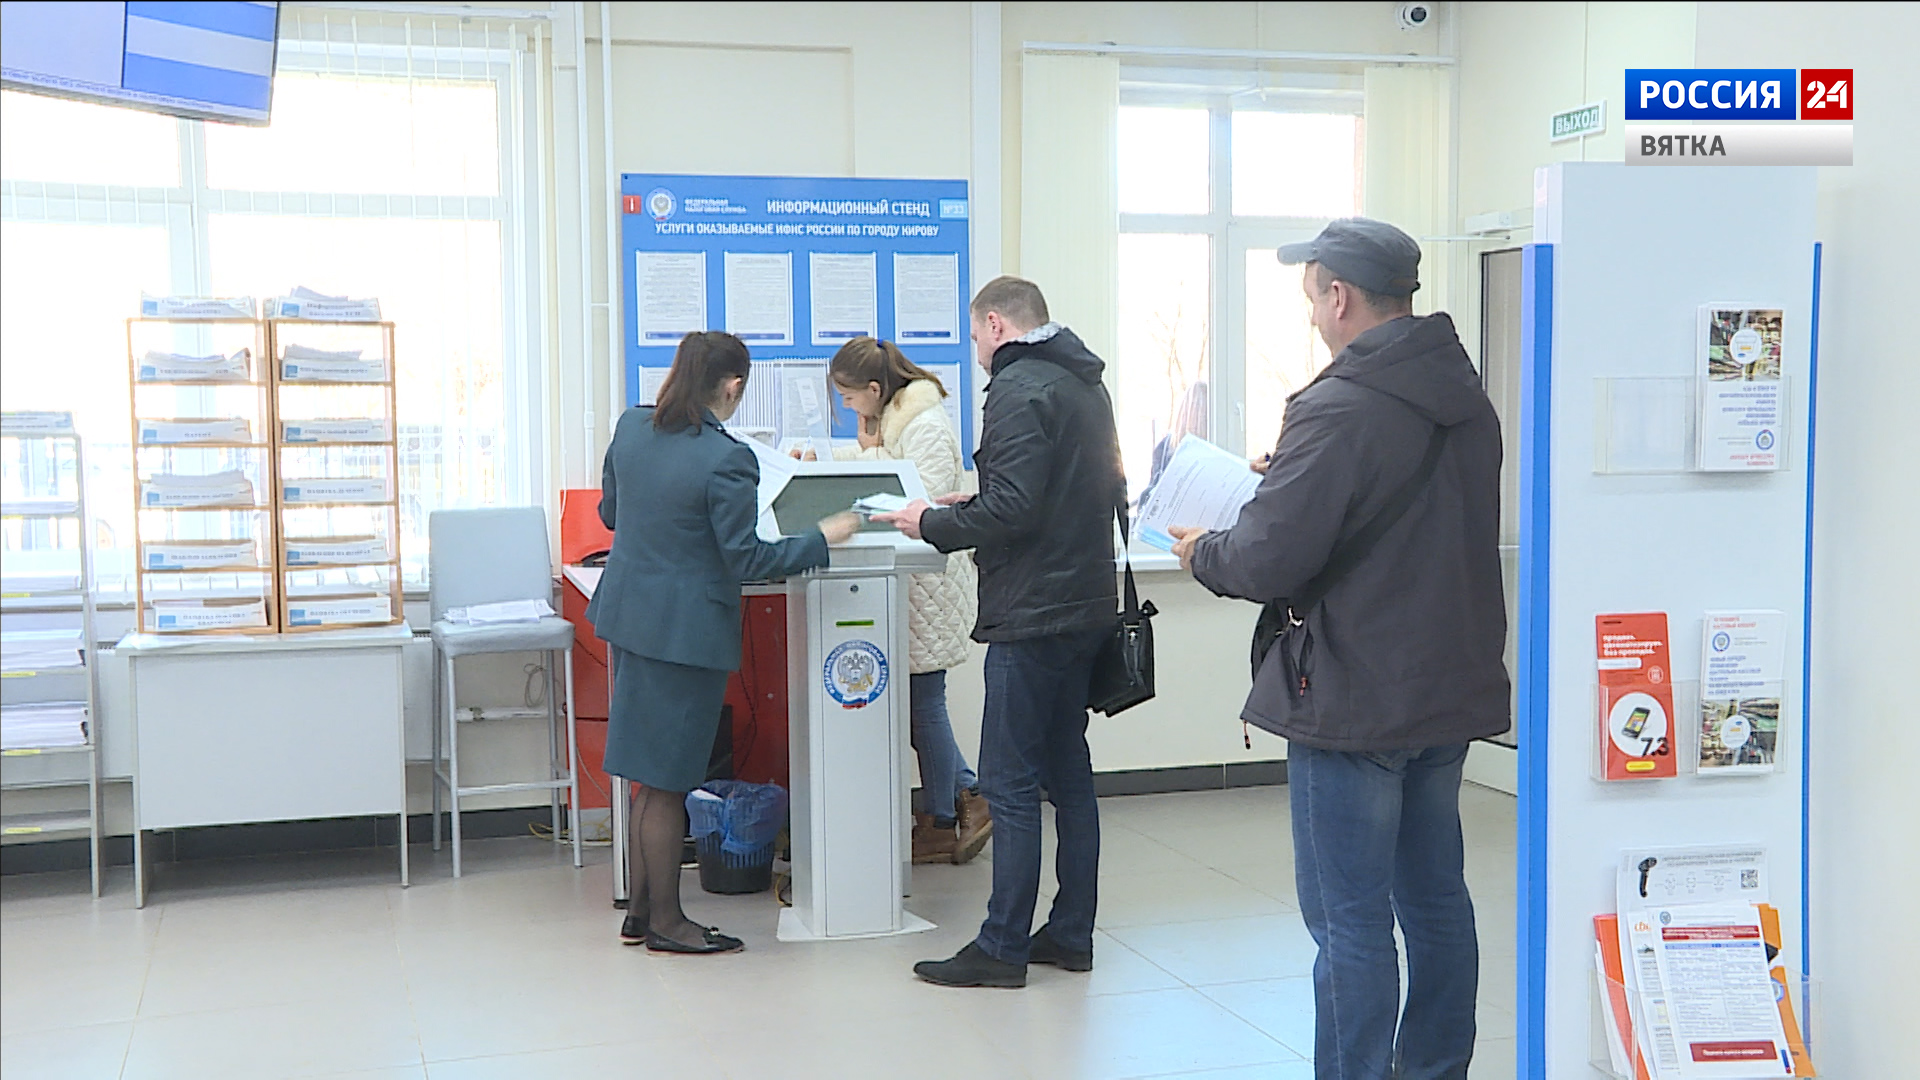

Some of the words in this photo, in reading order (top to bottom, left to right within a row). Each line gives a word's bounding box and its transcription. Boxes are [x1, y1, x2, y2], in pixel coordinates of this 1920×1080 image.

[1555, 110, 1600, 134] ВЫХОД
[767, 199, 888, 215] ИНФОРМАЦИОННЫЙ
[892, 202, 931, 217] СТЕНД
[655, 223, 694, 235] УСЛУГИ
[697, 223, 773, 235] ОКАЗЫВАЕМЫЕ
[776, 224, 805, 235] ИФНС
[806, 225, 845, 235] РОССИИ
[847, 225, 860, 236] ПО
[862, 225, 900, 237] ГОРОДУ
[902, 226, 940, 237] КИРОВУ
[1641, 737, 1669, 758] 7.3
